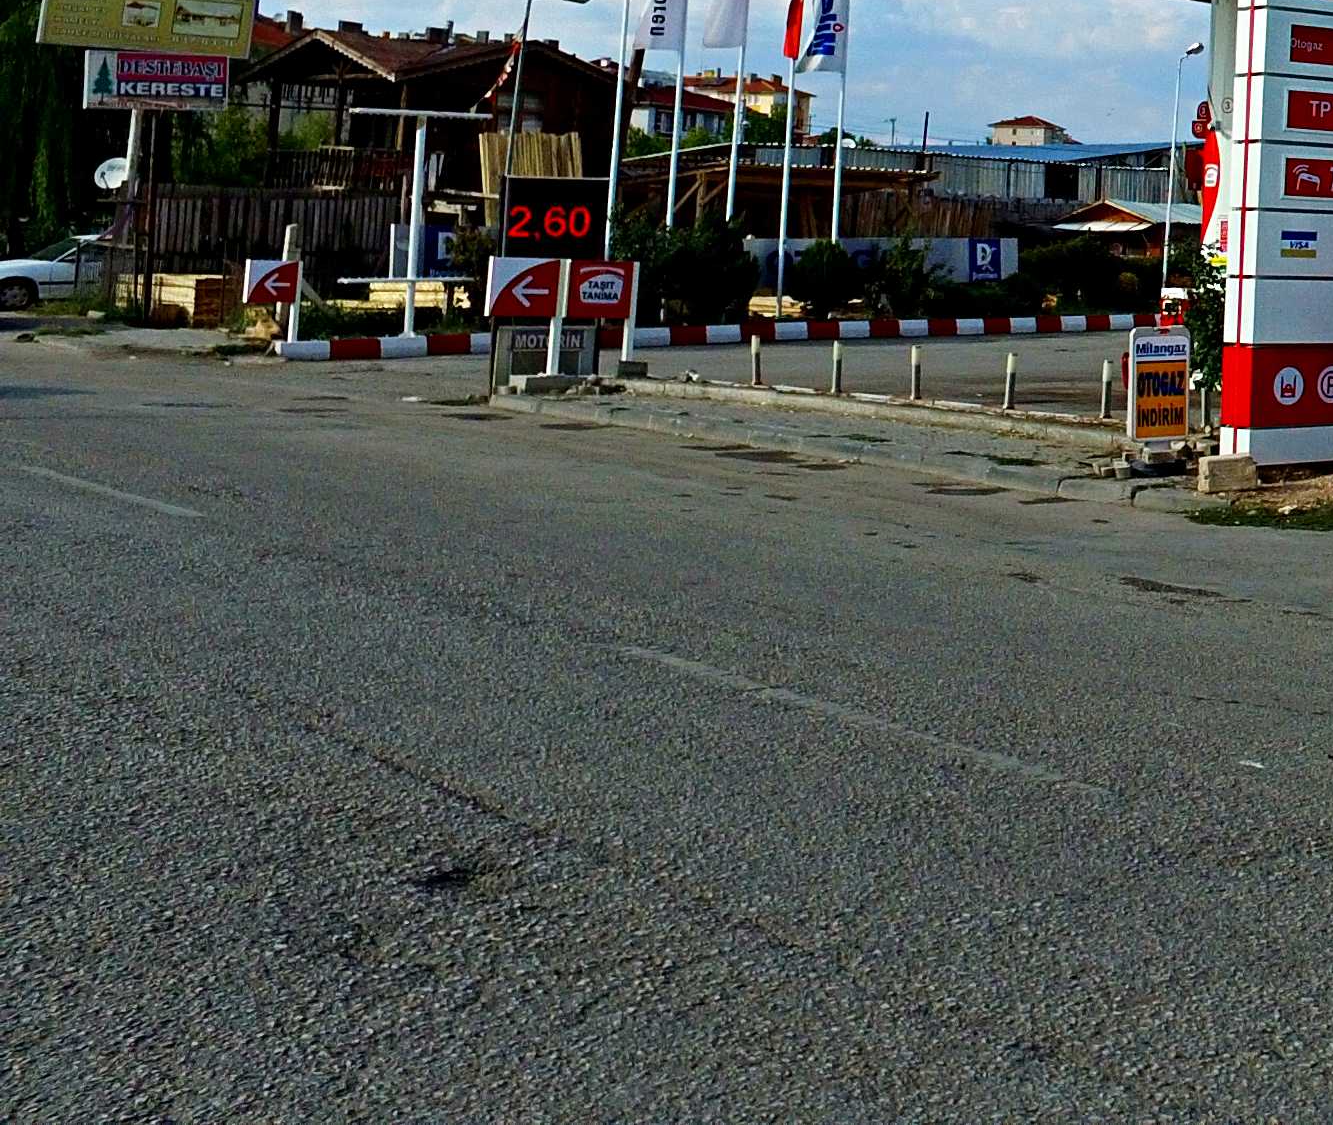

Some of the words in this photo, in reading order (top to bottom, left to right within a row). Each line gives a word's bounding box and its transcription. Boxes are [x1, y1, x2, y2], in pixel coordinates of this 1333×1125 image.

[1291, 37, 1323, 52] Otogaz
[119, 81, 224, 97] KERESTE
[1309, 100, 1331, 117] TP
[507, 205, 592, 242] 2,60
[1289, 240, 1310, 249] VISA
[587, 280, 615, 291] TAŞIT
[582, 291, 619, 301] TANIMA
[1136, 343, 1187, 356] Milangaz
[1136, 370, 1185, 398] OTOGAZ
[1136, 403, 1184, 428] İNDİRİM
